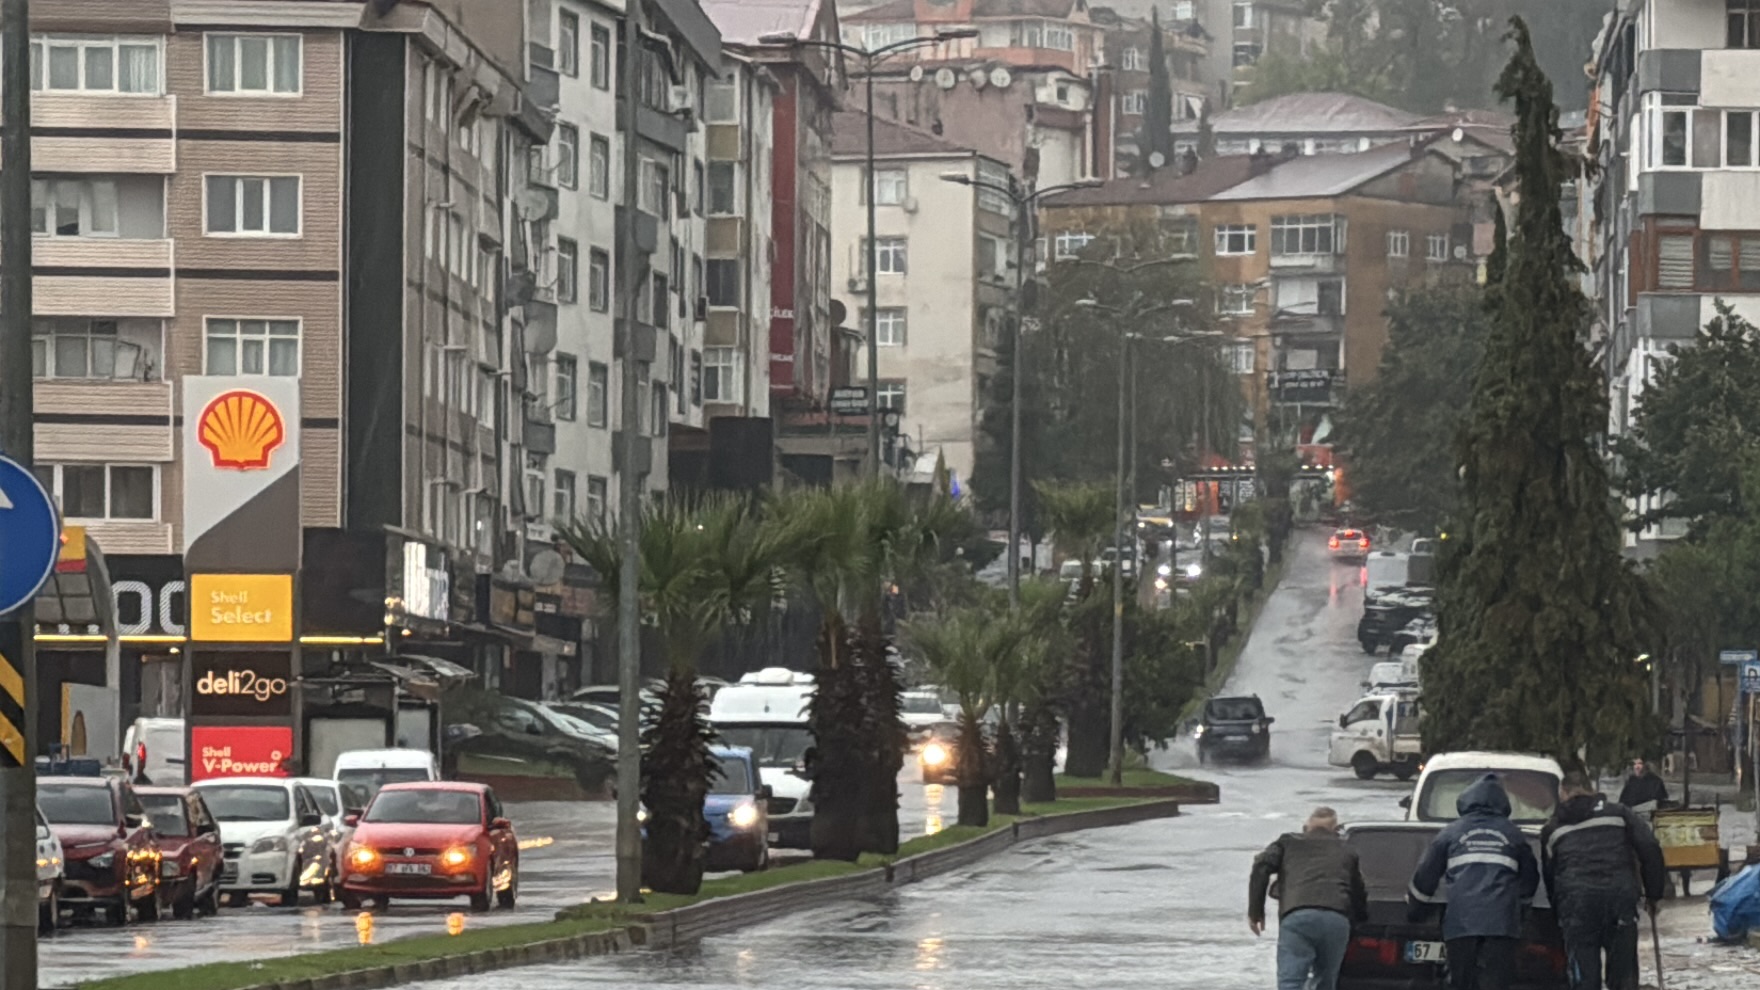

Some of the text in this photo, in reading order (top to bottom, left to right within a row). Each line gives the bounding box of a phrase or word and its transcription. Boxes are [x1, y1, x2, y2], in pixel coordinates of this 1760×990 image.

[211, 590, 248, 604] Shell
[211, 607, 273, 624] Select
[197, 669, 286, 701] deli2go
[202, 747, 231, 757] Shell
[202, 759, 278, 774] V-Power
[1414, 943, 1431, 959] 67
